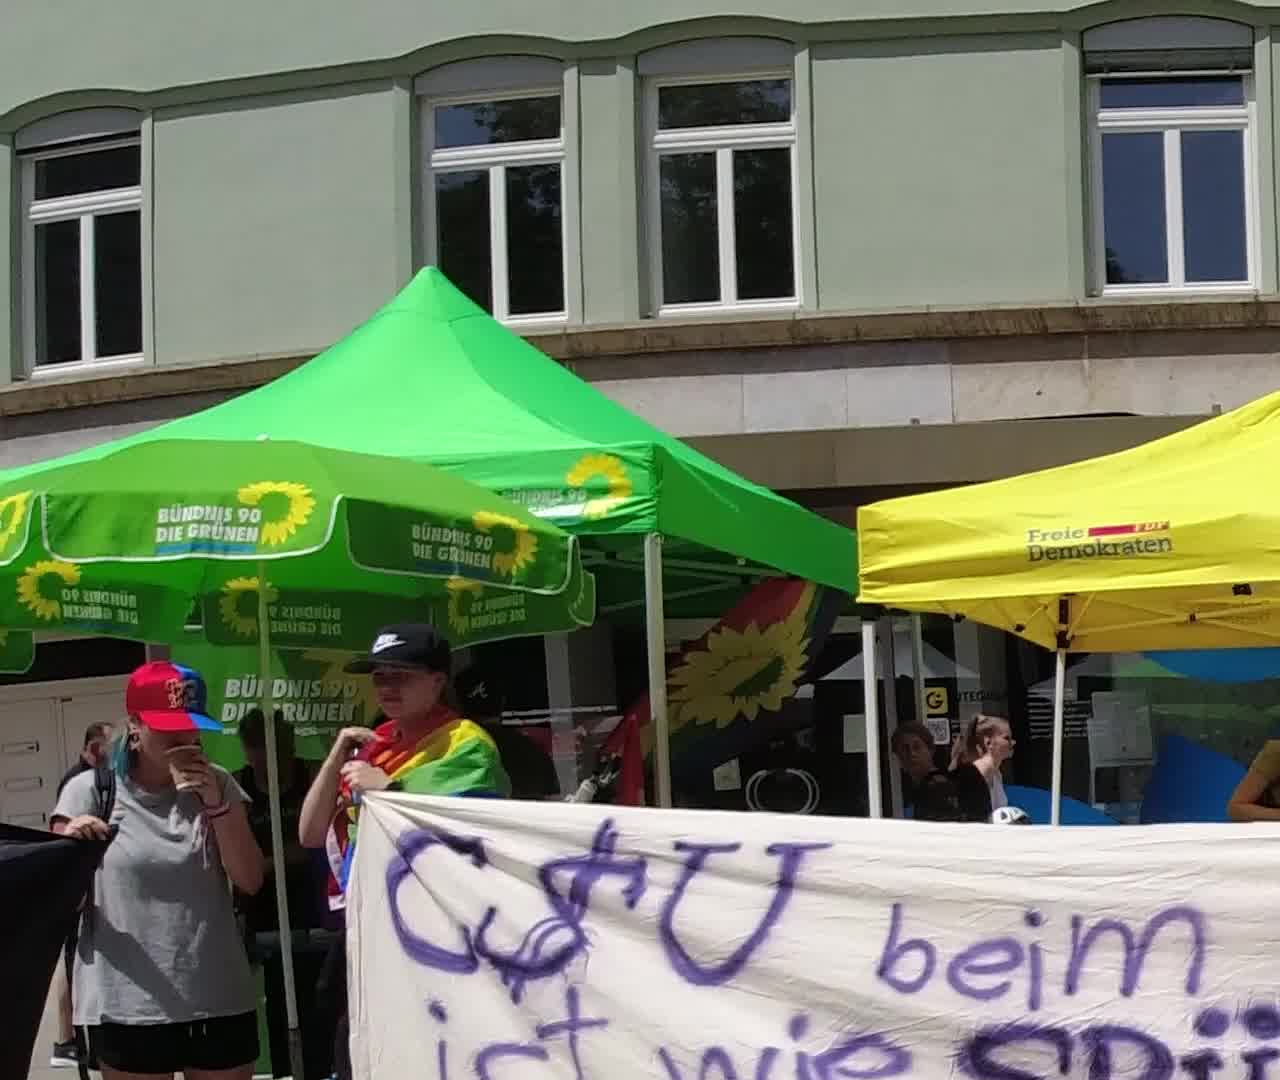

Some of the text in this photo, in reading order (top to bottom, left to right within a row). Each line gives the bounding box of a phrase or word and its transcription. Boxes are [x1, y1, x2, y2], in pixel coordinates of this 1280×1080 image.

[157, 504, 262, 523] BÜNDNIS 90
[155, 521, 259, 543] DIE GRÜNEN
[411, 522, 494, 550] BÜNDNIS 90
[1028, 526, 1084, 542] Freie
[1027, 537, 1173, 561] Demokraten
[877, 904, 1206, 1010] beim
